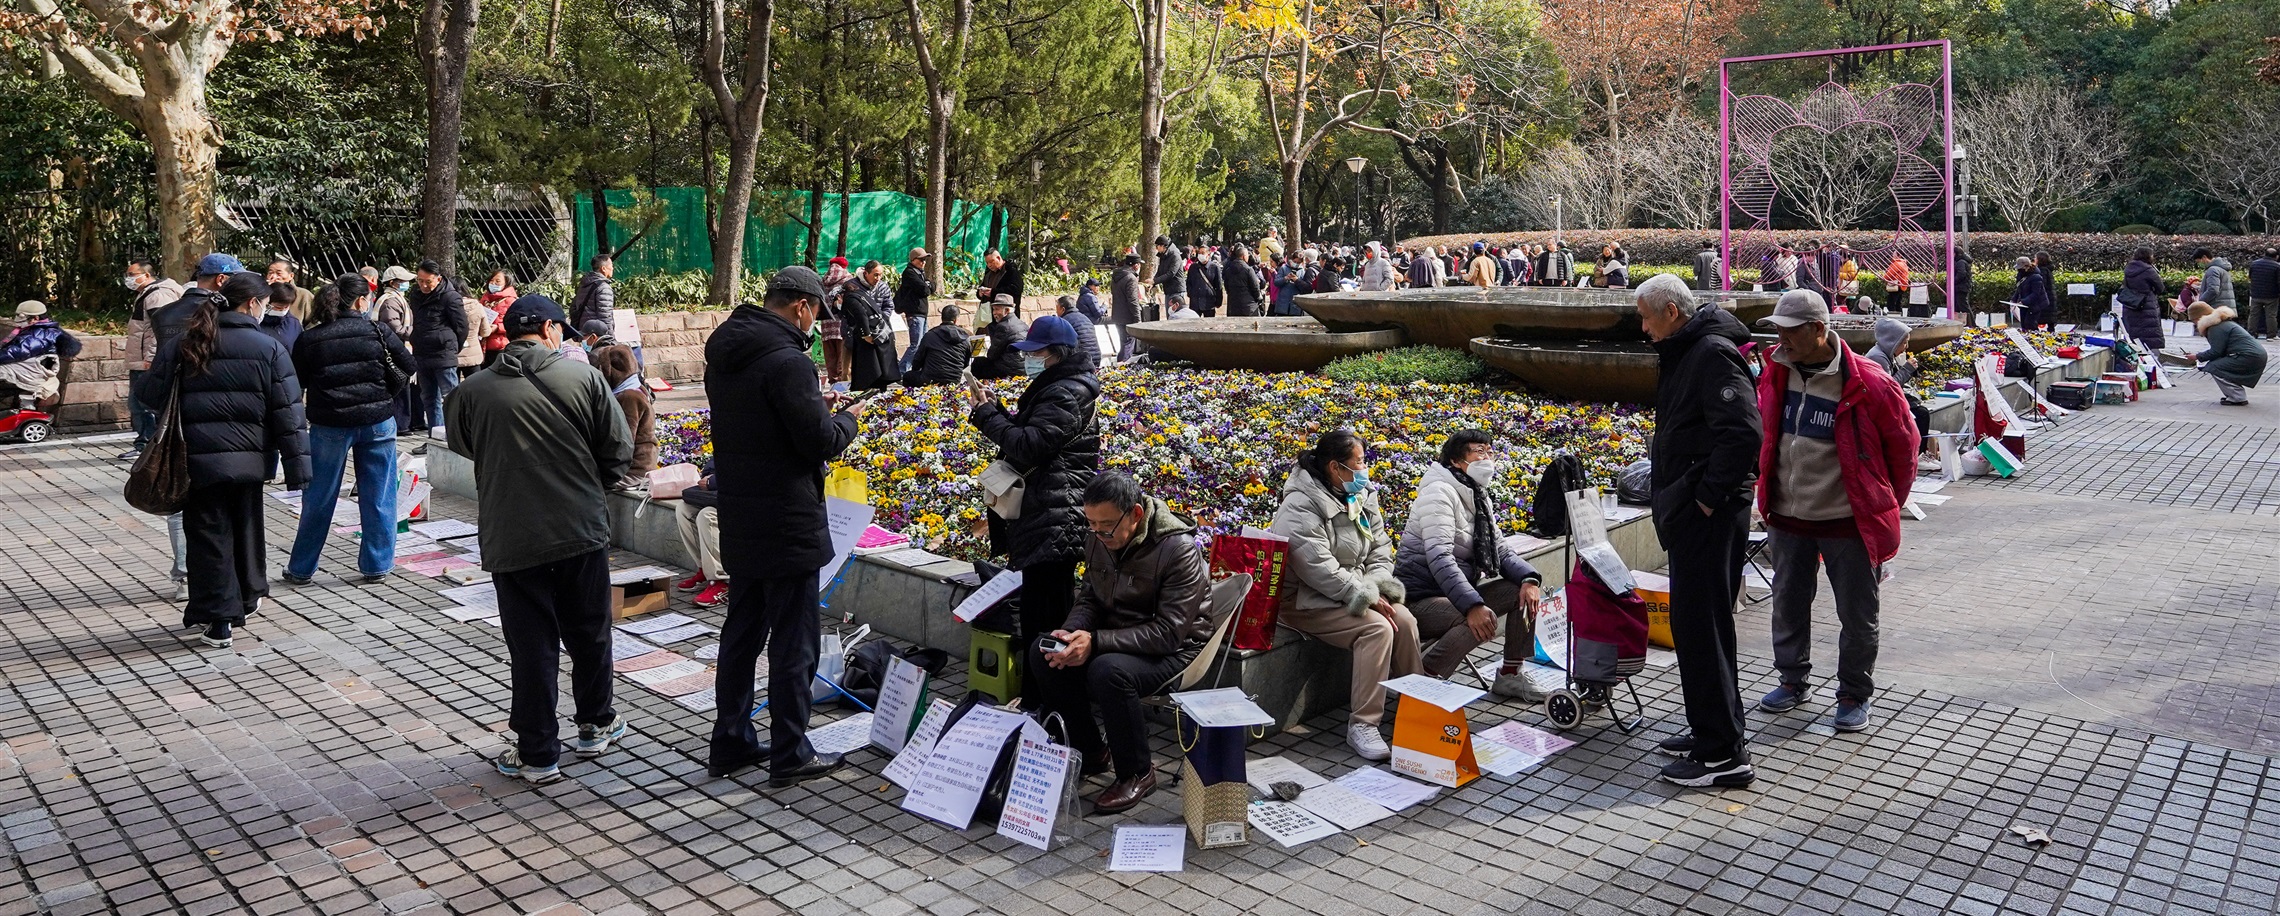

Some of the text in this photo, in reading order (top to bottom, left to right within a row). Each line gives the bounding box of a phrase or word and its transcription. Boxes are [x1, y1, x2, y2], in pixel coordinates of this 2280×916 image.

[1253, 550, 1266, 583] 怕上火
[1268, 551, 1284, 597] 喝加多宝
[1538, 596, 1565, 618] 女孩
[1649, 615, 1670, 626] 奥莱
[1034, 744, 1058, 756] 美国工作男孩
[1395, 757, 1422, 768] ONE SUSHI
[1395, 763, 1410, 771] START
[1264, 817, 1293, 827] 事业单位
